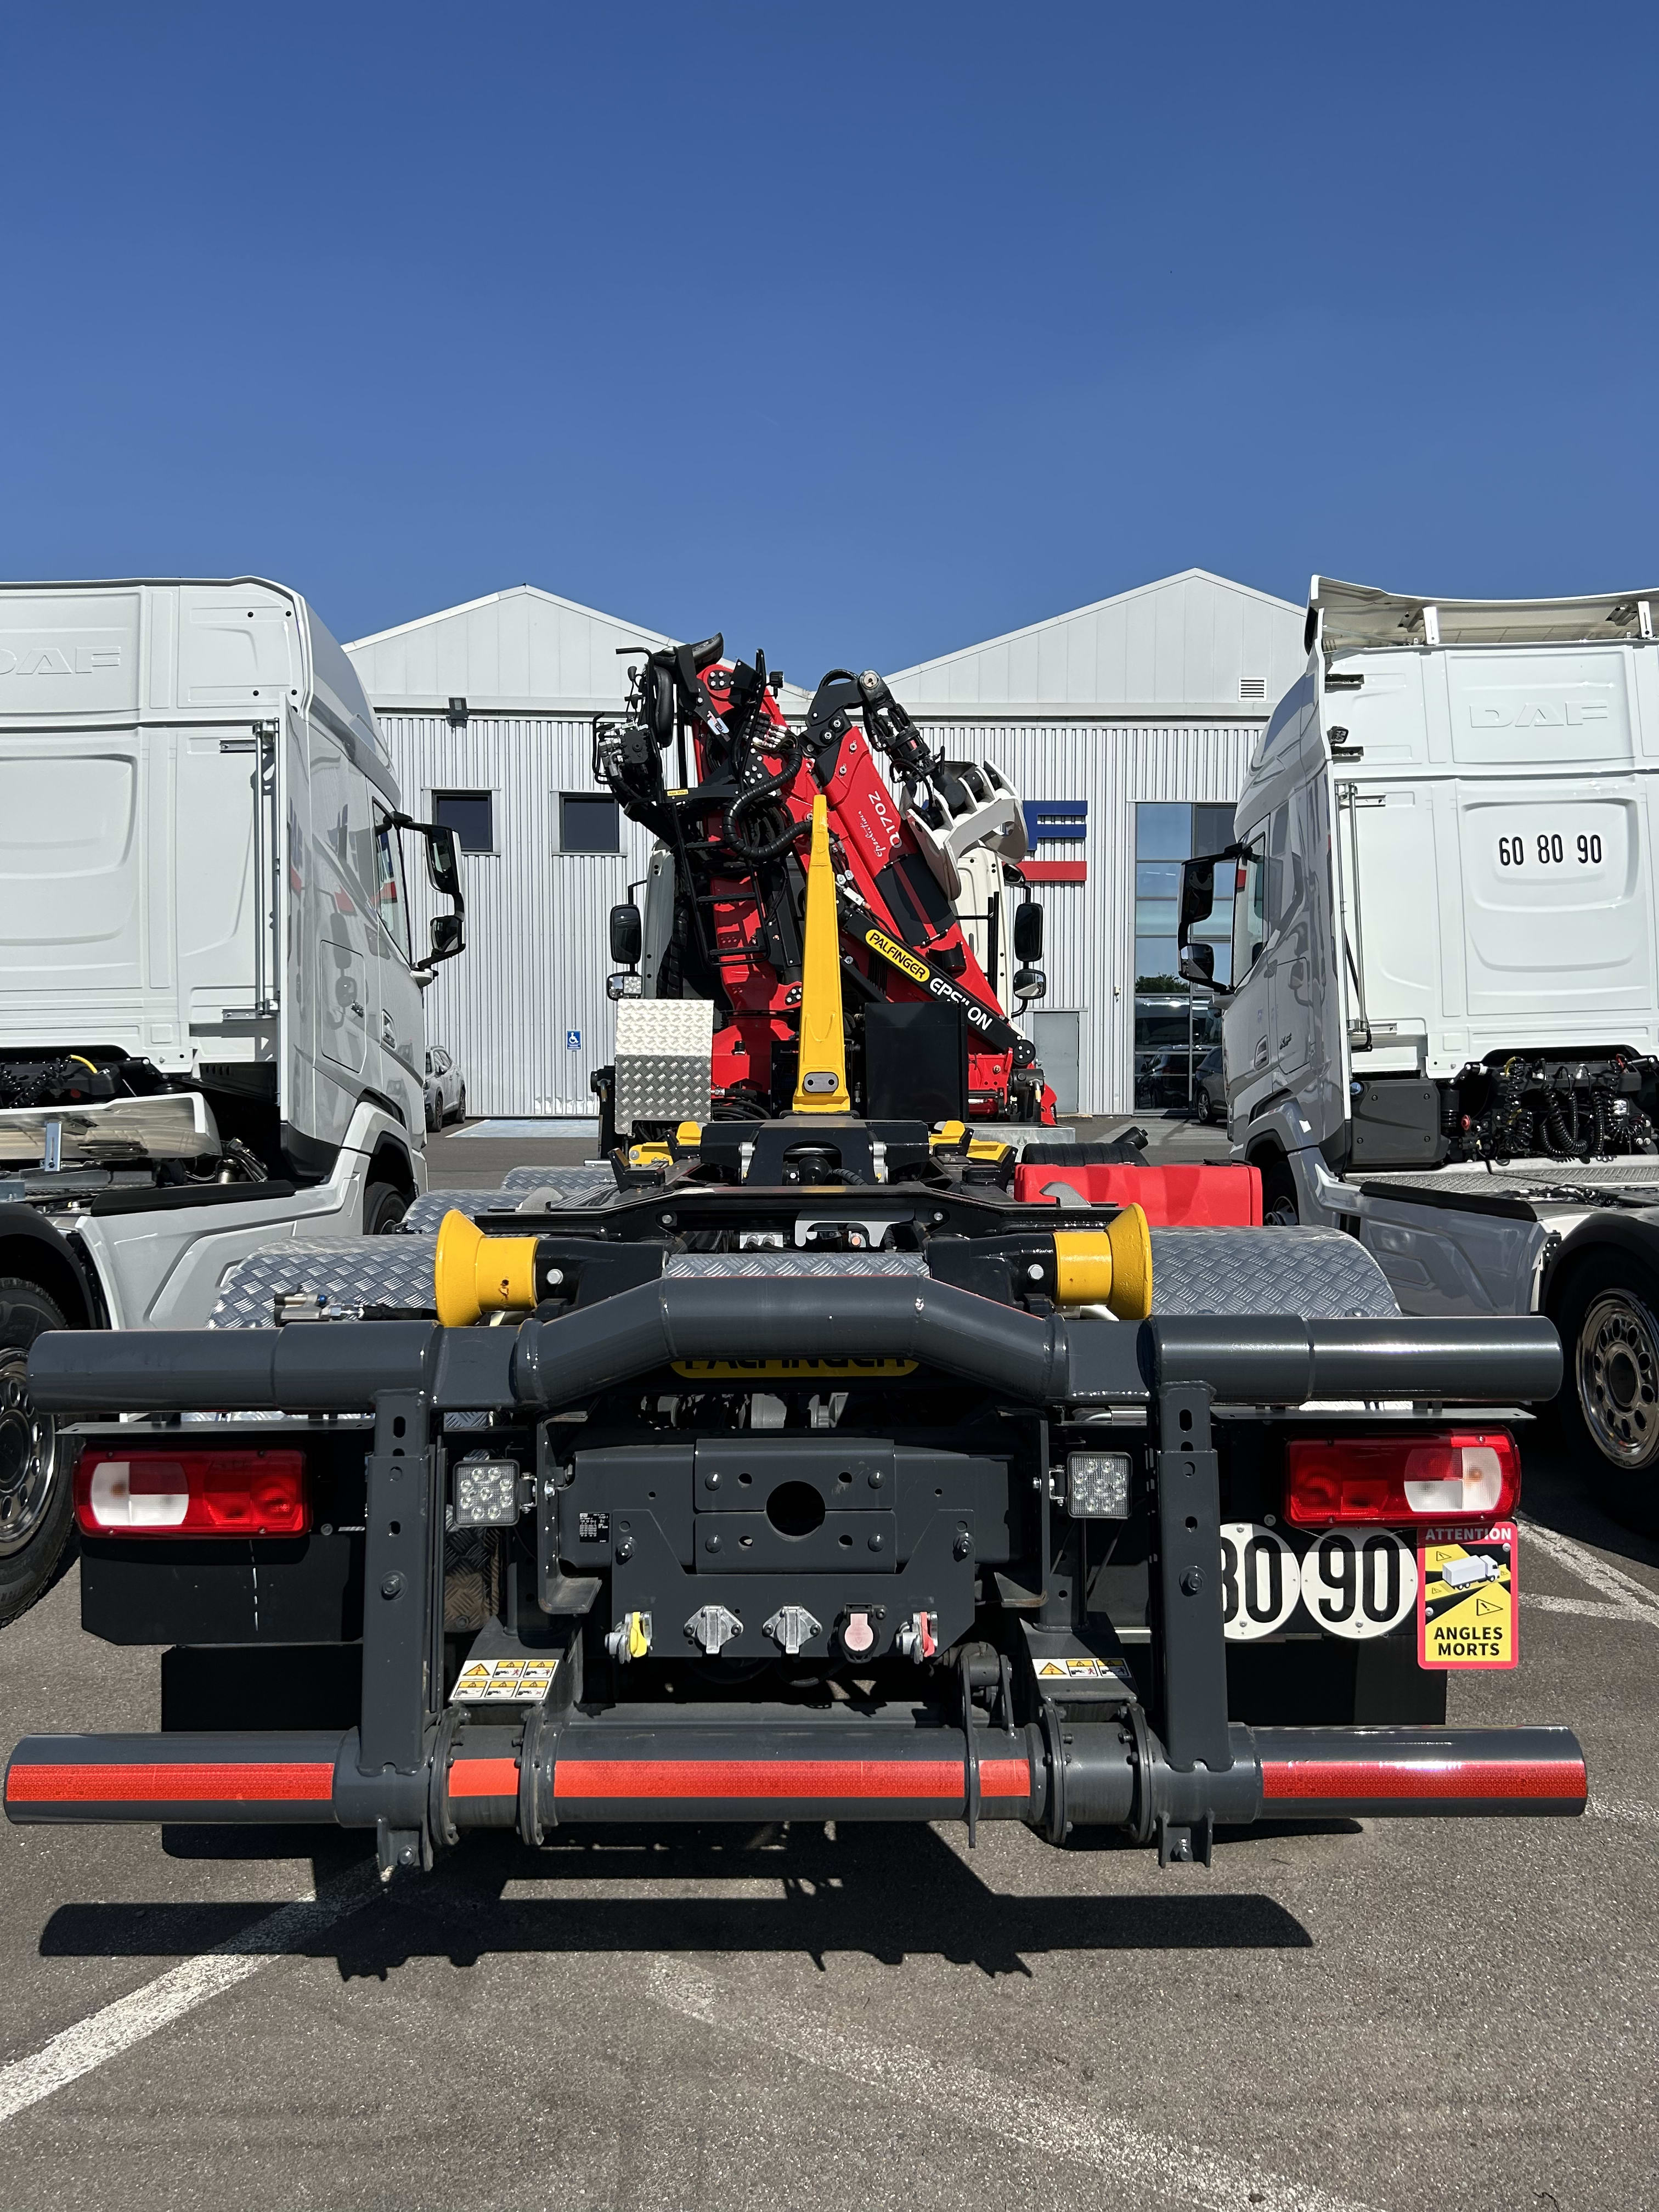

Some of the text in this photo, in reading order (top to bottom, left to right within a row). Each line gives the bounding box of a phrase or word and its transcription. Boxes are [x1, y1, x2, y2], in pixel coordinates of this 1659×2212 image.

[1469, 699, 1609, 728] DAF
[868, 791, 902, 848] Q170Z
[1498, 834, 1602, 866] 60 80 90
[869, 932, 994, 1031] PALFINGER EPSON
[1426, 1527, 1511, 1541] ATTENTION
[1318, 1534, 1400, 1623] 90
[1434, 1627, 1503, 1640] ANGLES
[1438, 1643, 1500, 1656] MORTS
